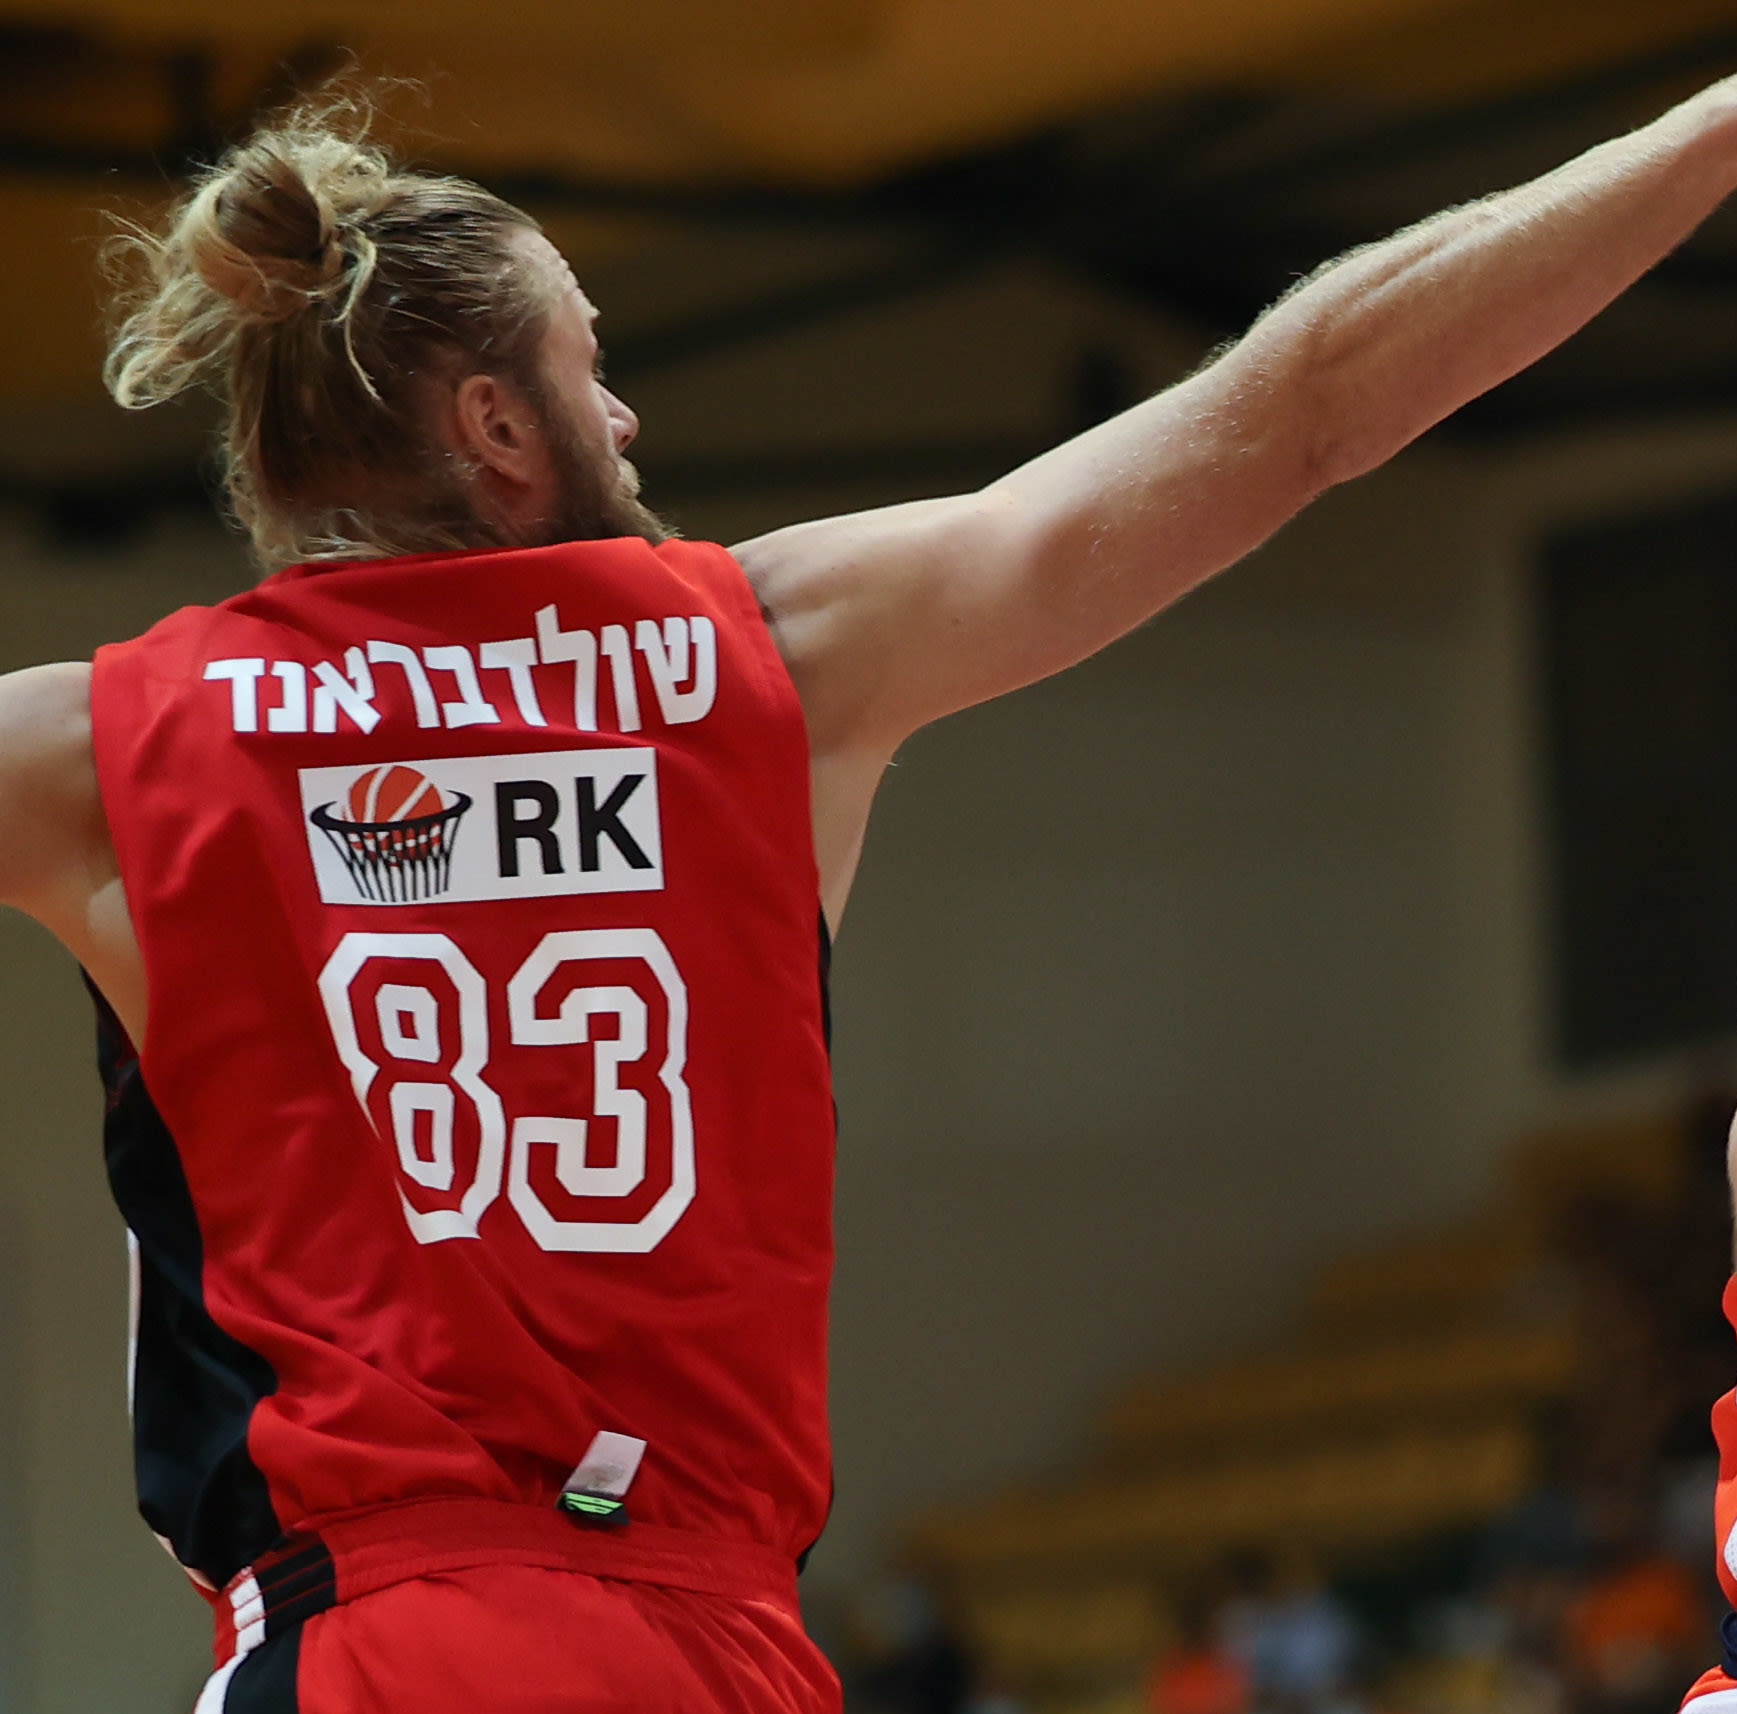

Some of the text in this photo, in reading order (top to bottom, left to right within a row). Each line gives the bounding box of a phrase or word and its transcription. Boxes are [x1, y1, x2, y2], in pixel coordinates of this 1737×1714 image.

[202, 604, 718, 735] שולדבראנד
[494, 774, 655, 878] RK
[317, 928, 697, 1252] 83
